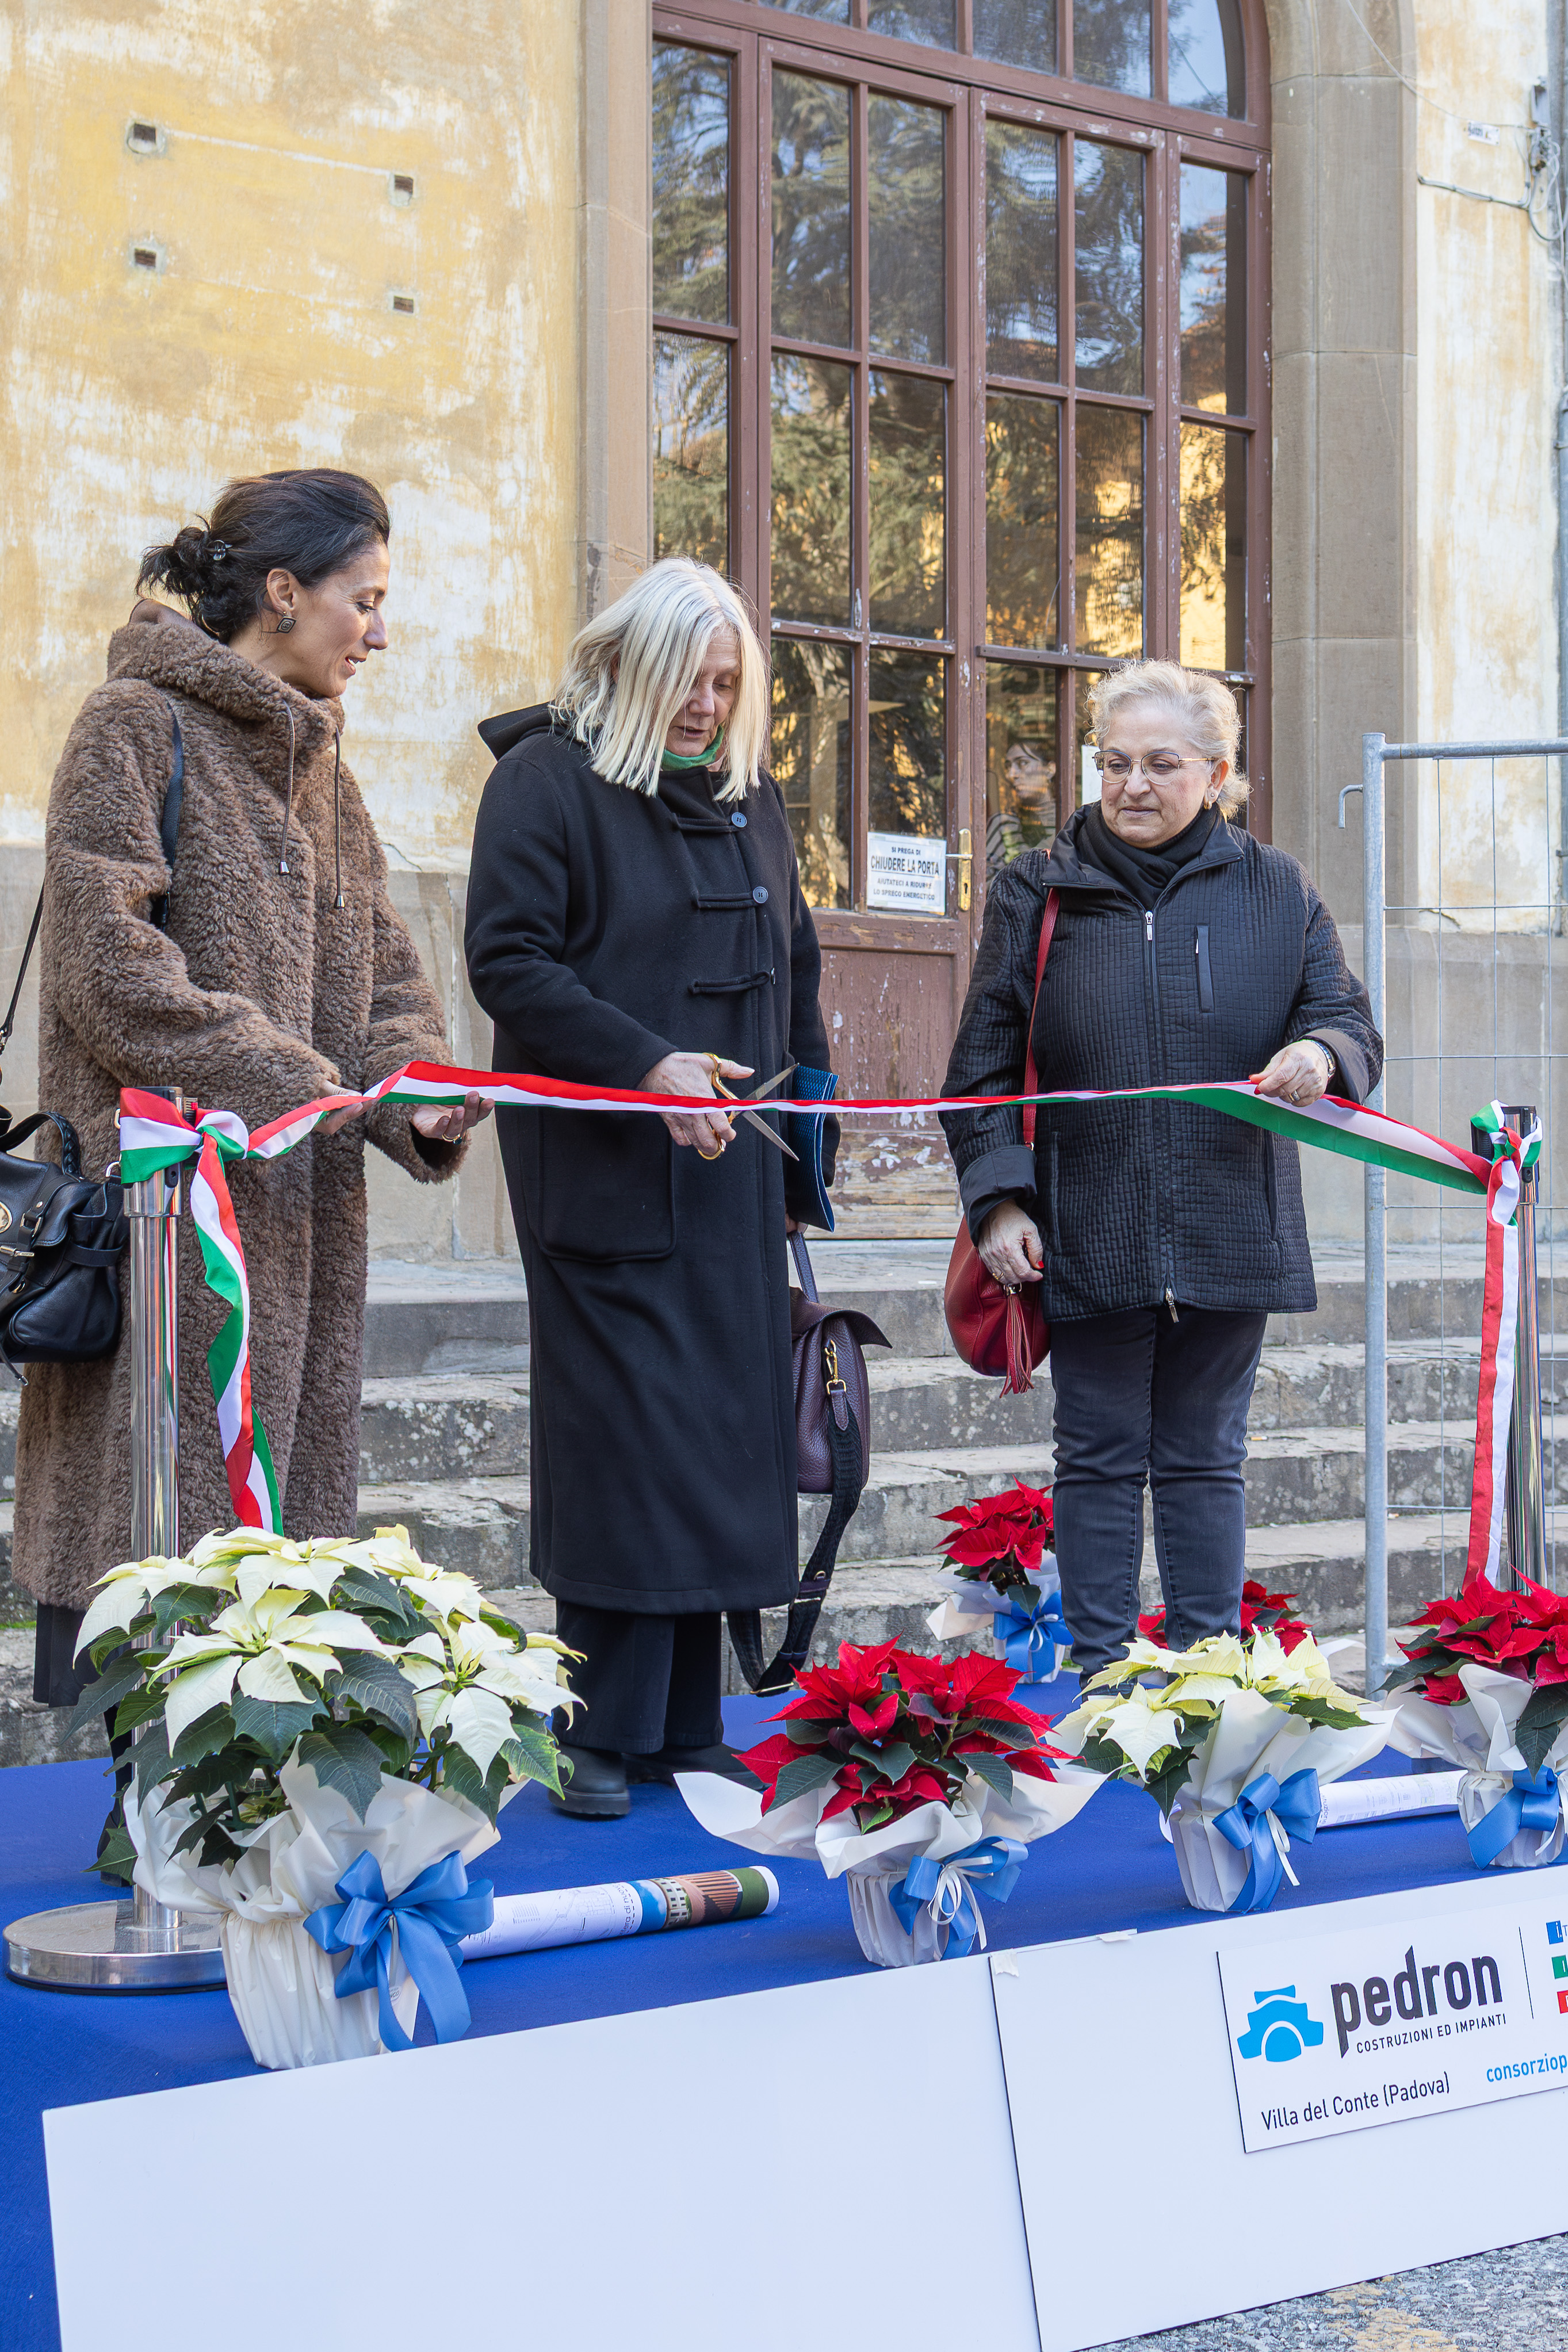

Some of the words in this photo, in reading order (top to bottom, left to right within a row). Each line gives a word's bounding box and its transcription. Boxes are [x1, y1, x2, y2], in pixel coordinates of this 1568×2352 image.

[871, 855, 905, 871] CHIUDERE
[908, 859, 915, 873] LA
[918, 861, 939, 875] PORTA
[877, 878, 904, 886] AIUTATECI
[903, 892, 935, 900] ENERGETICO
[1330, 1945, 1502, 2059] pedron
[1356, 2028, 1433, 2053] COSTRUZIONI
[1437, 2024, 1451, 2037] ED
[1455, 2013, 1506, 2033] IMPIANTI
[1486, 2053, 1567, 2082] consorziop
[1261, 2107, 1298, 2130] Villa
[1303, 2099, 1329, 2121] del
[1333, 2092, 1379, 2115] Conte
[1383, 2071, 1450, 2107] (Padova)
